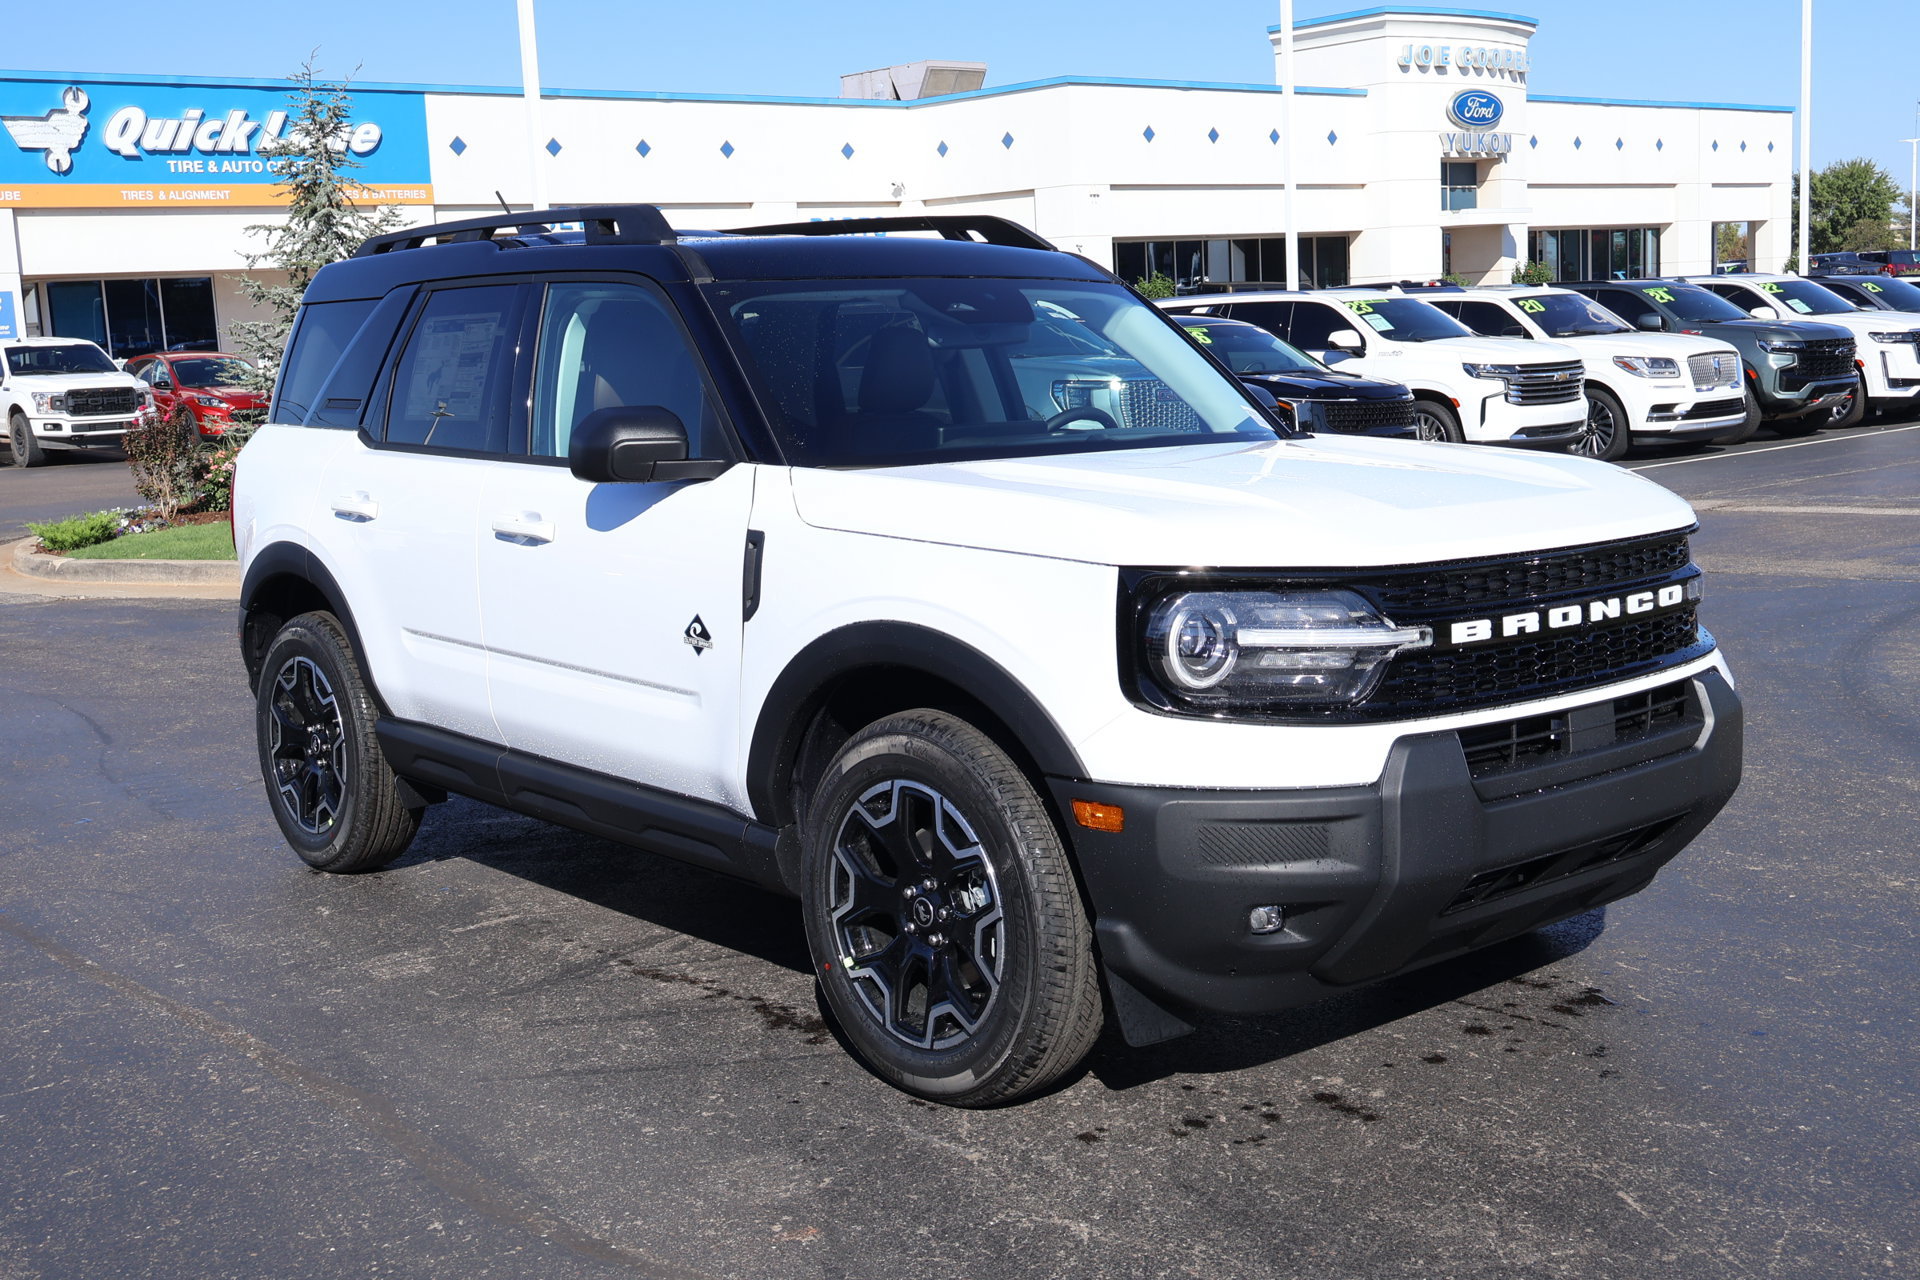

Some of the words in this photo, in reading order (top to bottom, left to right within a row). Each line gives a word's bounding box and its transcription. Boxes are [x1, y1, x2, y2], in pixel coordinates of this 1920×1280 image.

[1400, 44, 1451, 65] JOE
[1464, 96, 1495, 118] Ford
[104, 106, 259, 156] Quick
[1446, 133, 1512, 152] YUKON
[167, 160, 204, 173] TIRE
[208, 160, 218, 173] &
[222, 160, 263, 173] AUTO
[266, 160, 325, 173] CET
[121, 190, 154, 200] TIRES
[159, 191, 167, 200] &
[169, 190, 230, 200] ALIGNMENT
[362, 190, 369, 199] &
[372, 190, 426, 199] BATTERIES
[1518, 299, 1546, 313] 20
[68, 394, 133, 406] FORD
[1451, 585, 1682, 644] BRONCO
